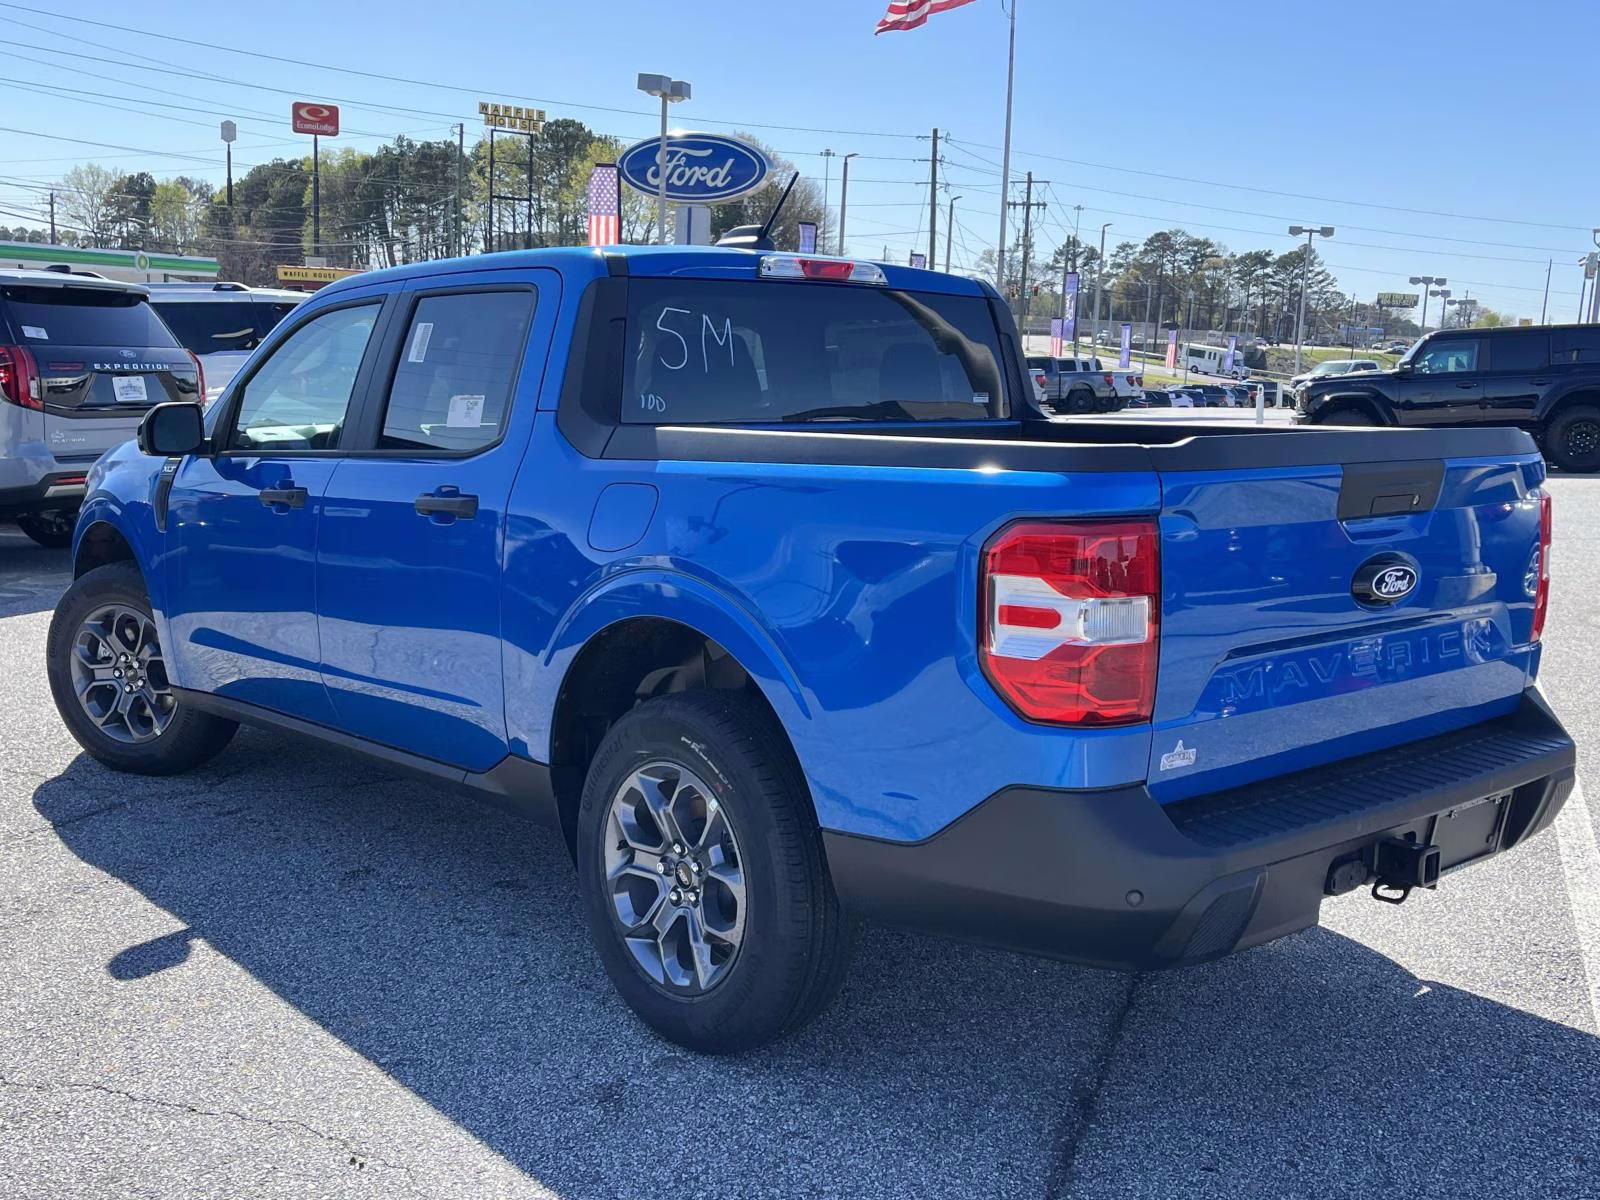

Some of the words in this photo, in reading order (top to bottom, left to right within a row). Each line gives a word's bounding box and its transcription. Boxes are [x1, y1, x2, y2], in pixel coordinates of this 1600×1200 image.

[481, 103, 543, 120] WAFFLE
[487, 116, 539, 131] HOUSE
[646, 146, 735, 188] Ford
[1381, 570, 1410, 593] Ford
[1221, 619, 1493, 704] MAVERICK
